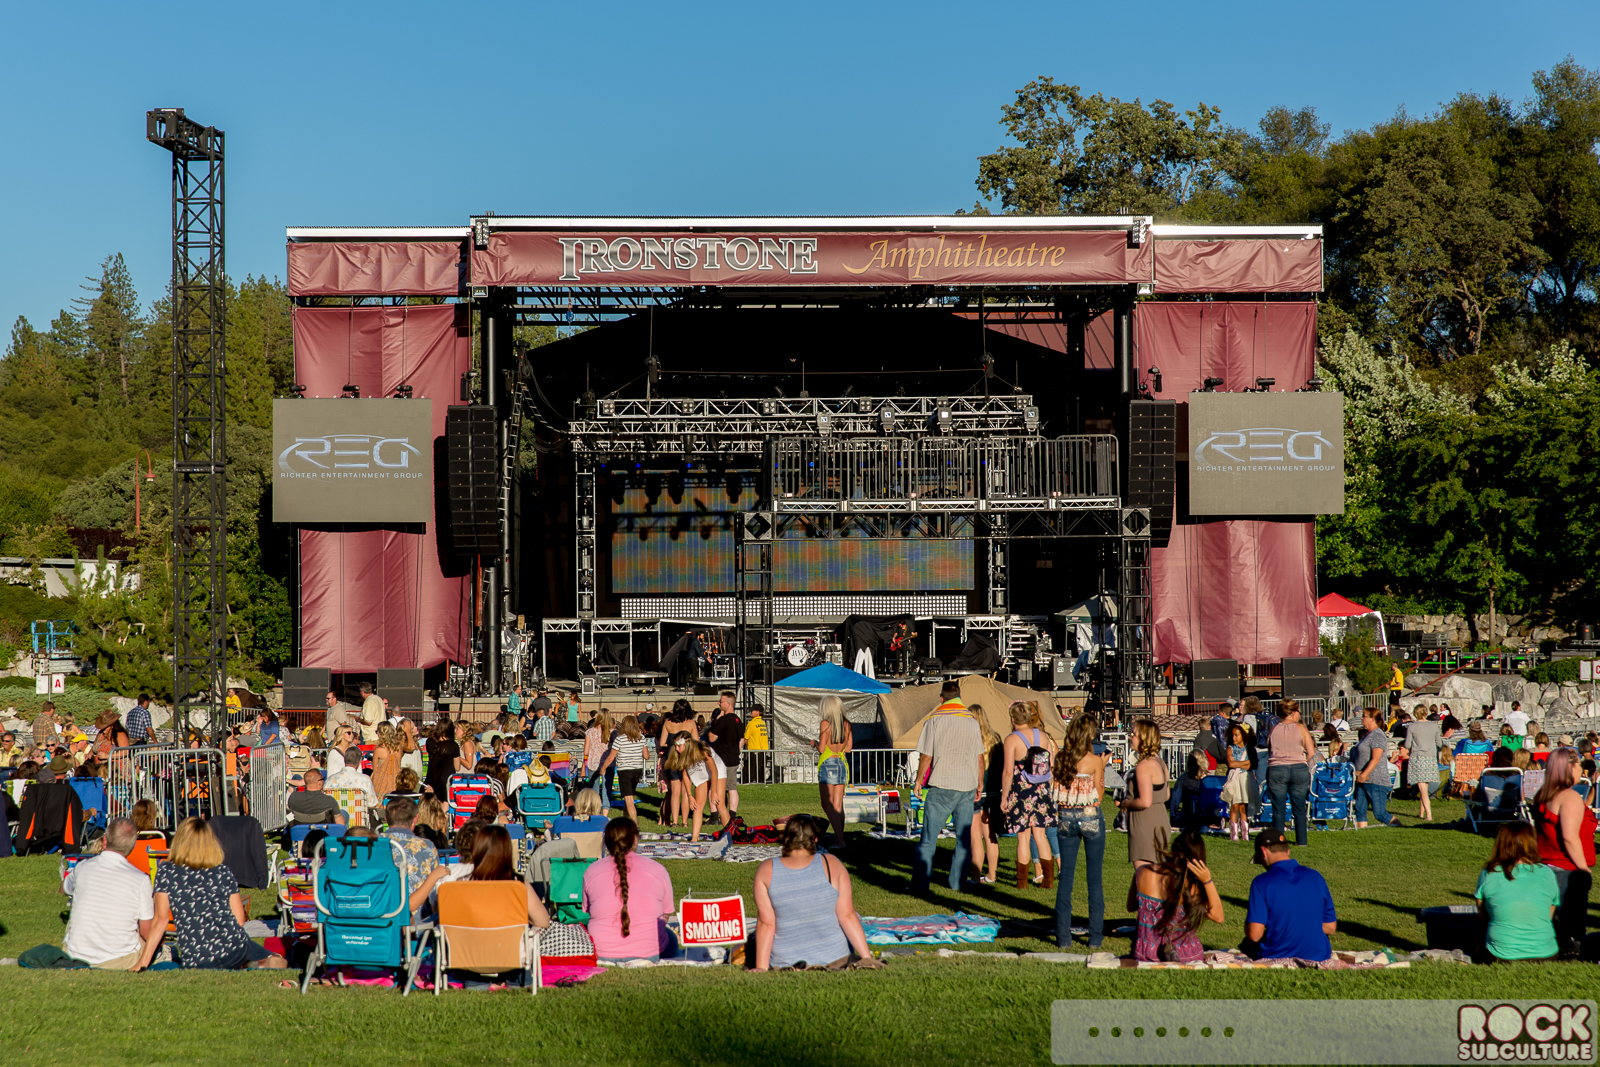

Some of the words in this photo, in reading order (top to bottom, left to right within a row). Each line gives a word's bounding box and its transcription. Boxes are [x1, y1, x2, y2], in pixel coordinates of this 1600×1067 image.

[558, 237, 818, 281] IRONSTONE
[842, 234, 1066, 279] Amphitheatre
[295, 437, 409, 469] REG
[1211, 430, 1322, 462] REG
[54, 679, 61, 688] A
[702, 903, 720, 921] NO
[685, 919, 741, 940] SMOKING
